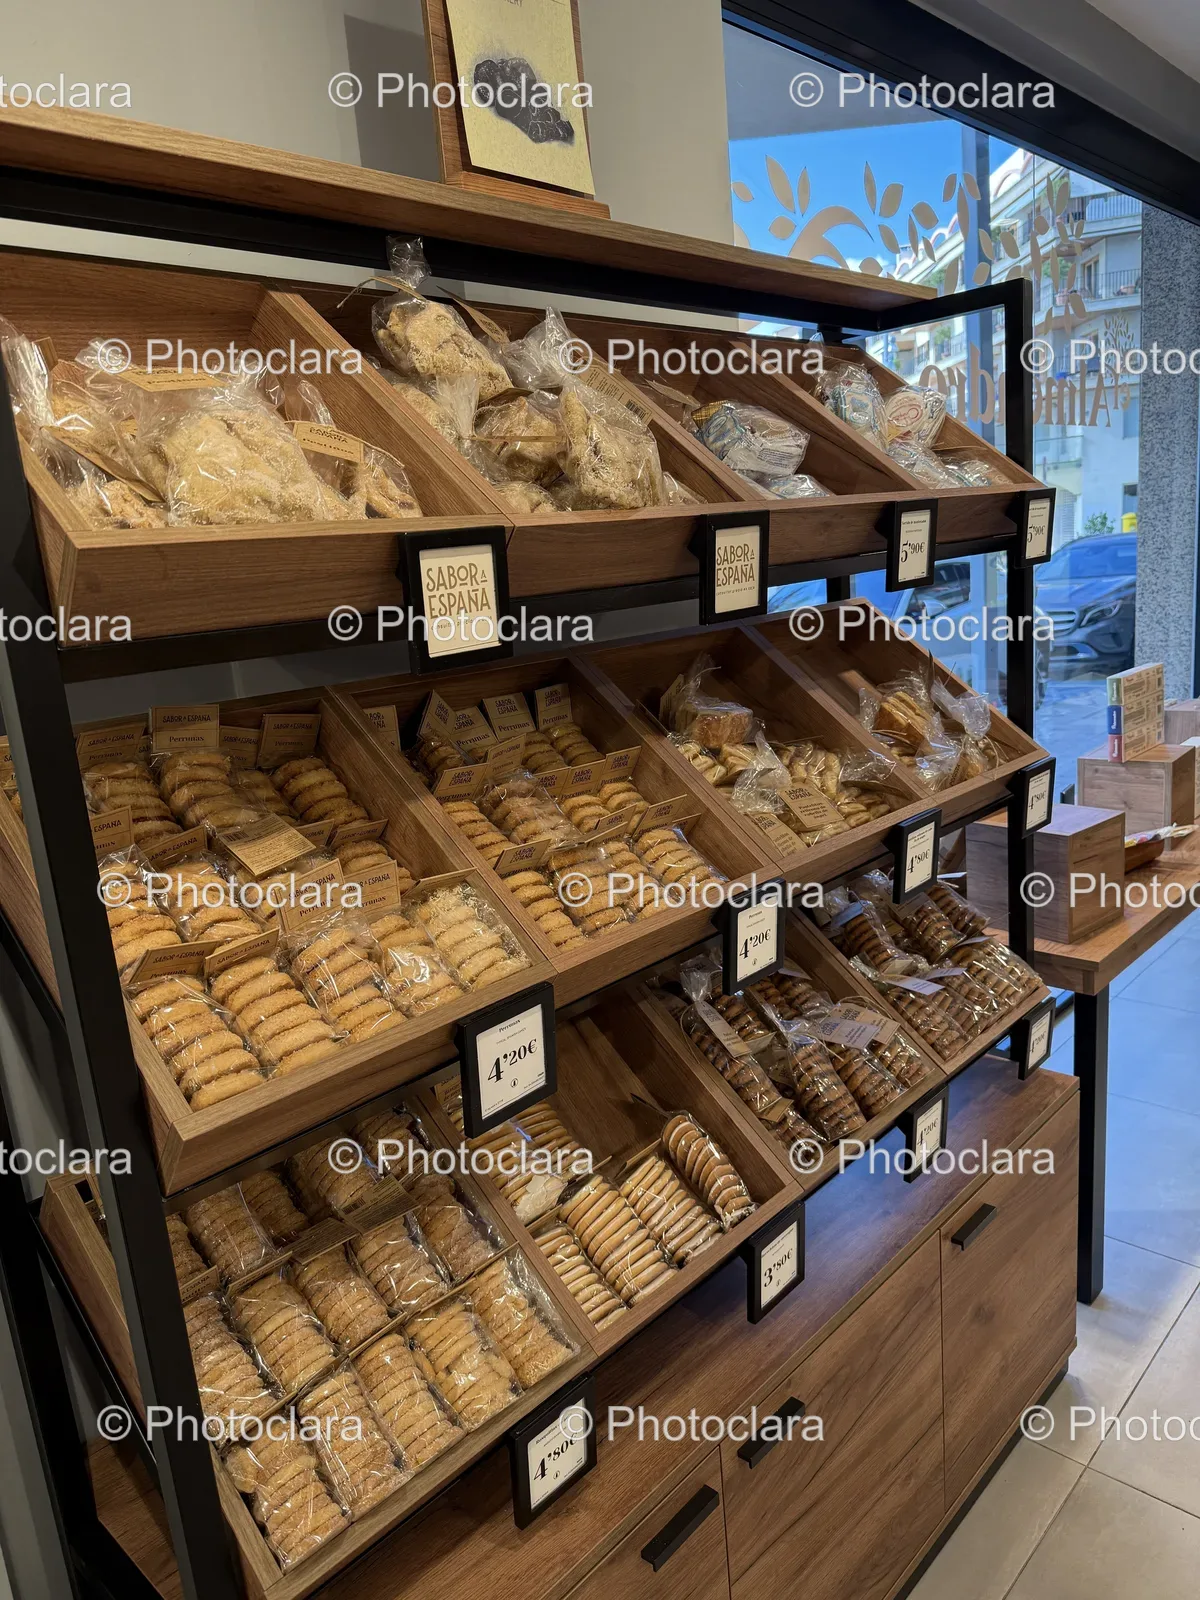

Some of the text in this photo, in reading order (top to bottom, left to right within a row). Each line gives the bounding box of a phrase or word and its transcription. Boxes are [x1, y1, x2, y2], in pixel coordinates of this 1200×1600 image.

[716, 543, 755, 566] SABOR A
[426, 563, 488, 592] SABOR A
[716, 563, 755, 587] ESPAÑA
[428, 588, 491, 619] ESPAÑA
[163, 715, 183, 723] SABOR
[187, 714, 211, 722] ESPAÑA
[498, 721, 530, 732] Perrunas
[169, 735, 205, 743] Perrunas
[94, 819, 122, 833] ESPAÑA
[171, 837, 198, 851] ESPAÑA
[368, 873, 391, 886] ESPAÑA
[739, 928, 771, 960] 4'20€
[487, 1038, 538, 1083] 4'20€
[763, 1247, 793, 1288] 3'80€
